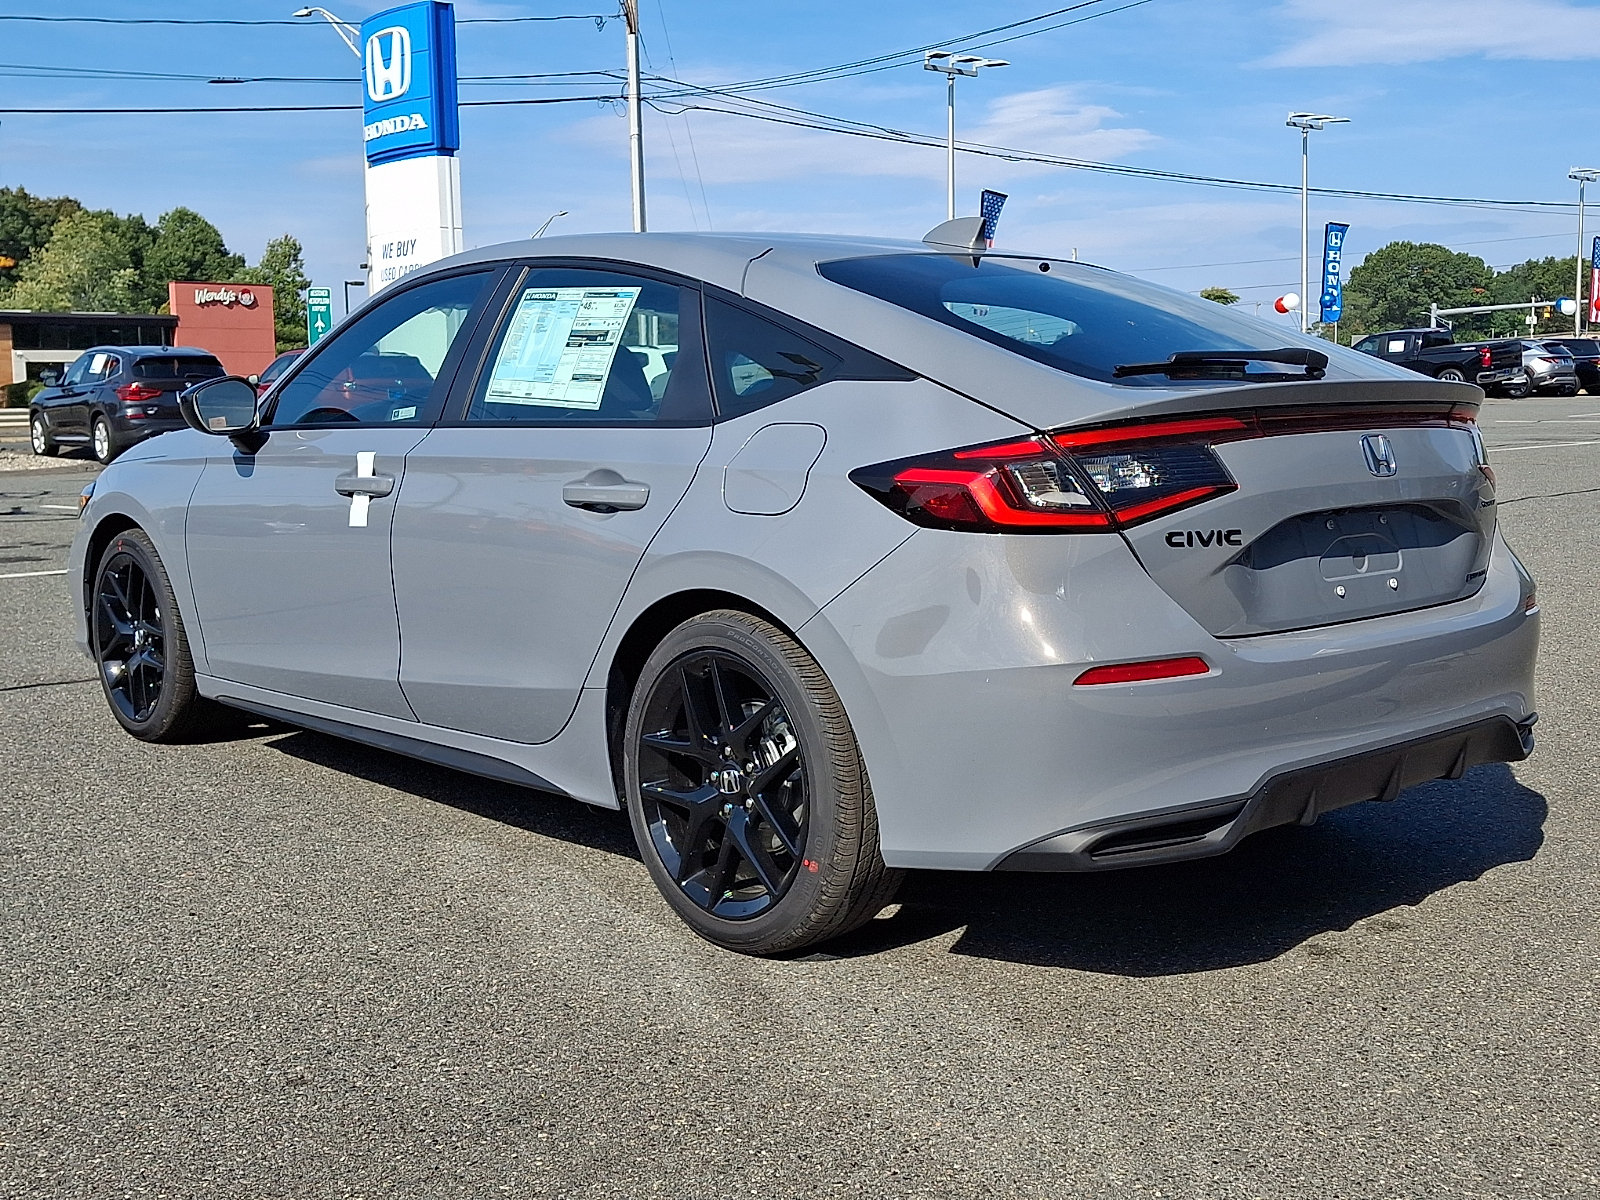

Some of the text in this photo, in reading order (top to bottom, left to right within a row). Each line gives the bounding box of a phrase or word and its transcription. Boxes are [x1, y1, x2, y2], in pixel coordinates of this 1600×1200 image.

[364, 113, 428, 142] HONDA
[382, 239, 416, 259] WE BUY
[381, 266, 396, 282] USED
[195, 287, 235, 305] Wendy's
[1165, 529, 1242, 548] CIVIC
